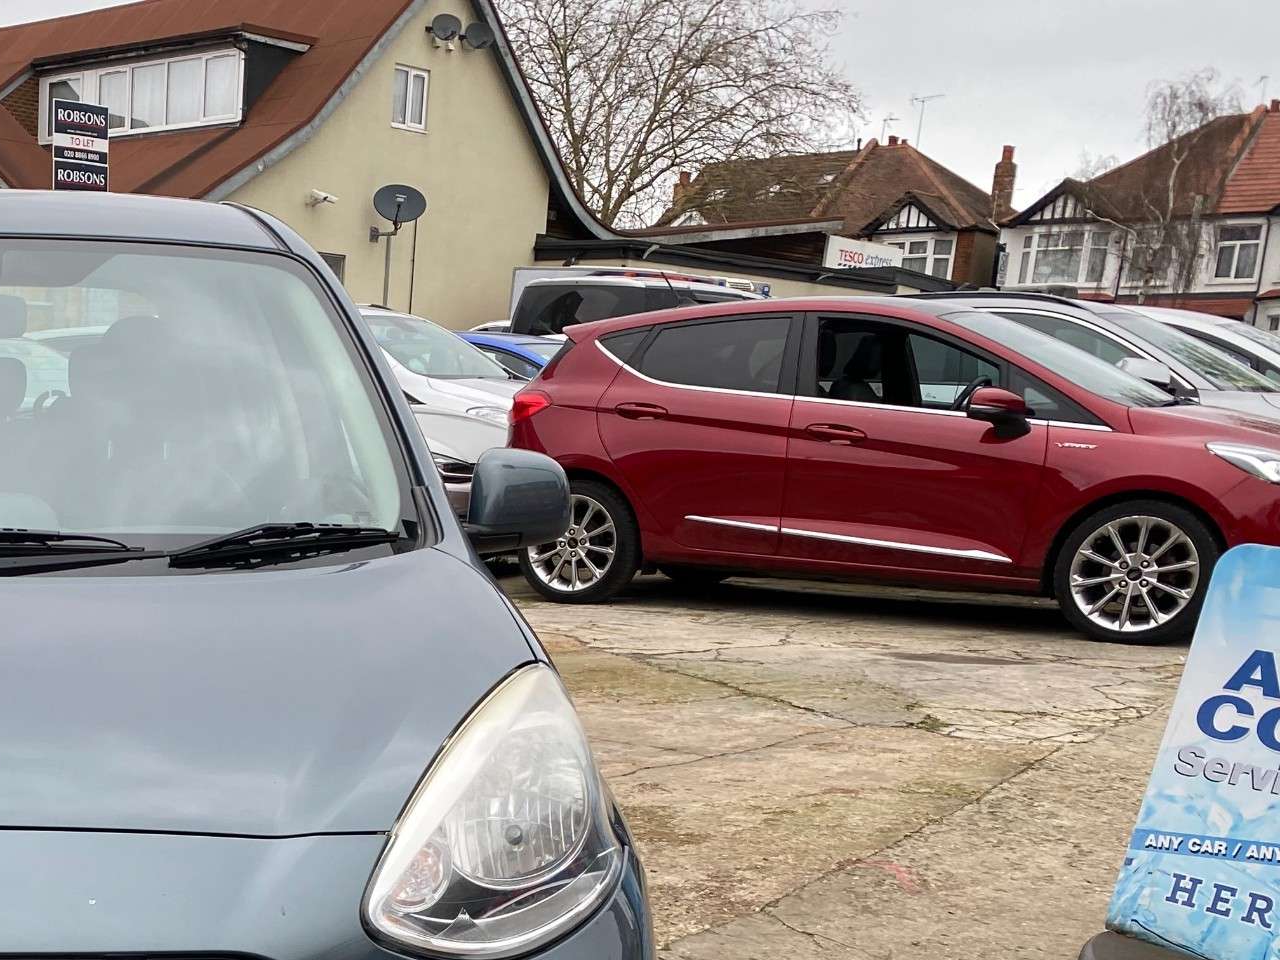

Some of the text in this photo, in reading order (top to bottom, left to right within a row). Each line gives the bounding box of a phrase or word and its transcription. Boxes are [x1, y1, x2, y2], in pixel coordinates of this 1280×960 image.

[57, 108, 106, 127] ROBSONS
[70, 136, 95, 149] TO LET
[57, 168, 105, 186] ROBSONS
[839, 249, 864, 265] TESCO
[1145, 834, 1182, 851] ANY
[1188, 838, 1227, 856] CAR
